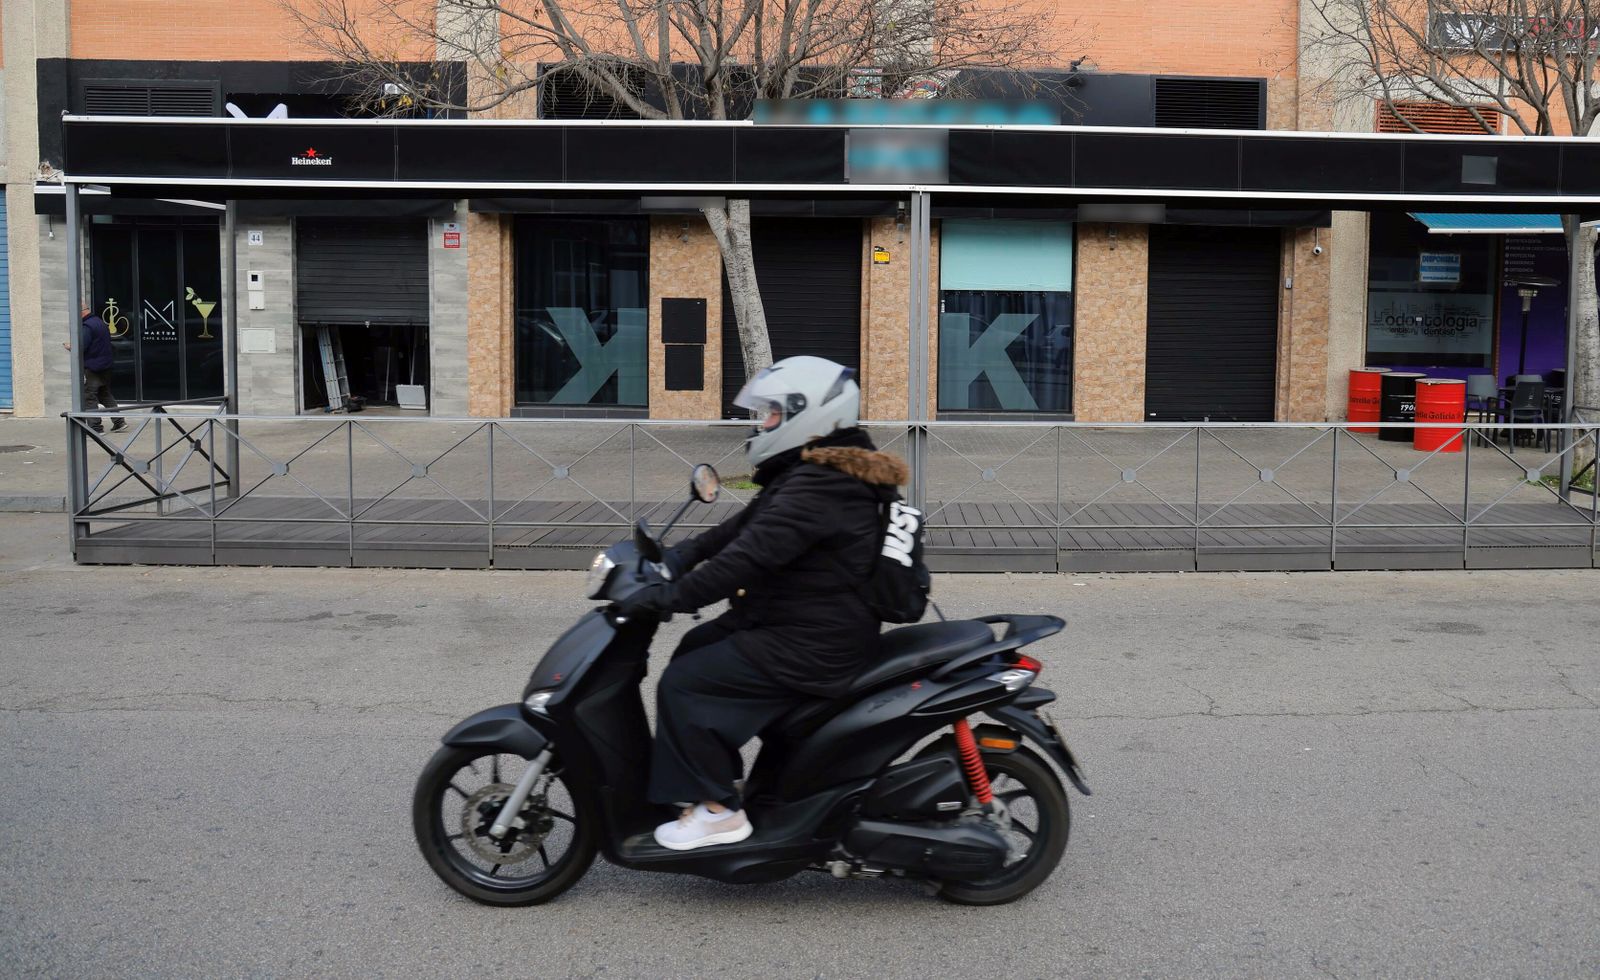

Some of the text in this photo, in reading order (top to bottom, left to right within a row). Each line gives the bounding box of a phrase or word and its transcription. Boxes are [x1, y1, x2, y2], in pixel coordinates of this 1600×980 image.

[291, 156, 332, 166] Heineken
[251, 234, 260, 242] 44
[939, 312, 1041, 410] K
